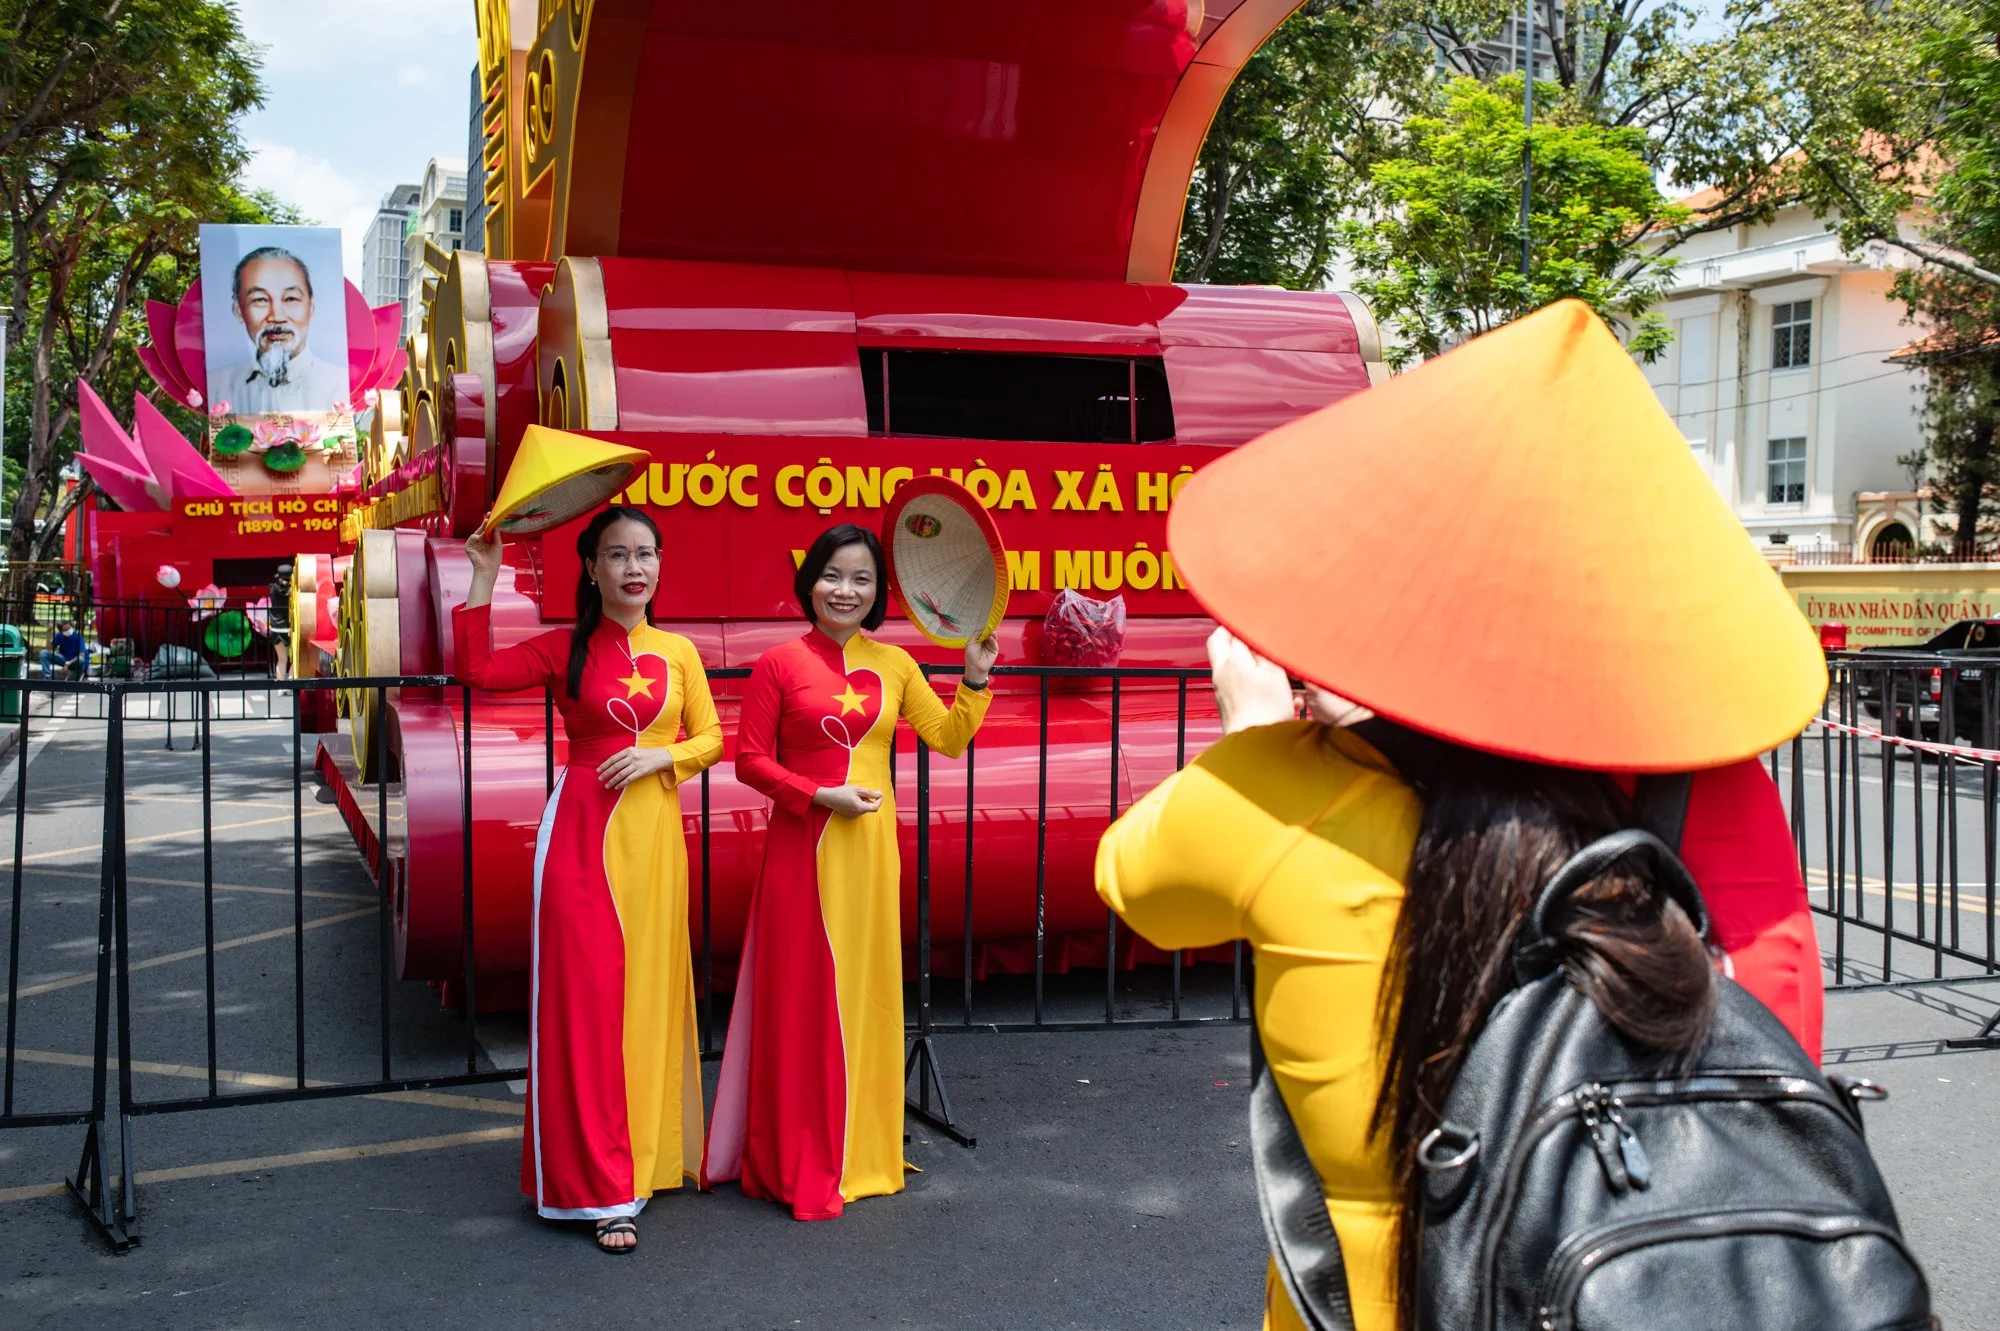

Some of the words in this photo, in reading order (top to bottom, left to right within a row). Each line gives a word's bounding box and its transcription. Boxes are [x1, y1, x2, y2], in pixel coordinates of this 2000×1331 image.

[610, 449, 759, 508] NƯỚC
[1052, 463, 1124, 511] XÃ
[184, 499, 224, 517] CHỦ
[229, 501, 274, 516] TỊCH
[278, 495, 308, 514] HỒ
[313, 499, 338, 513] CH
[237, 518, 285, 535] (1890
[1829, 602, 1857, 619] BAN
[1859, 598, 1900, 620] NHÂN
[1903, 598, 1935, 620] DÂN
[1856, 626, 1914, 637] COMMITTEE
[1917, 627, 1931, 637] OF
